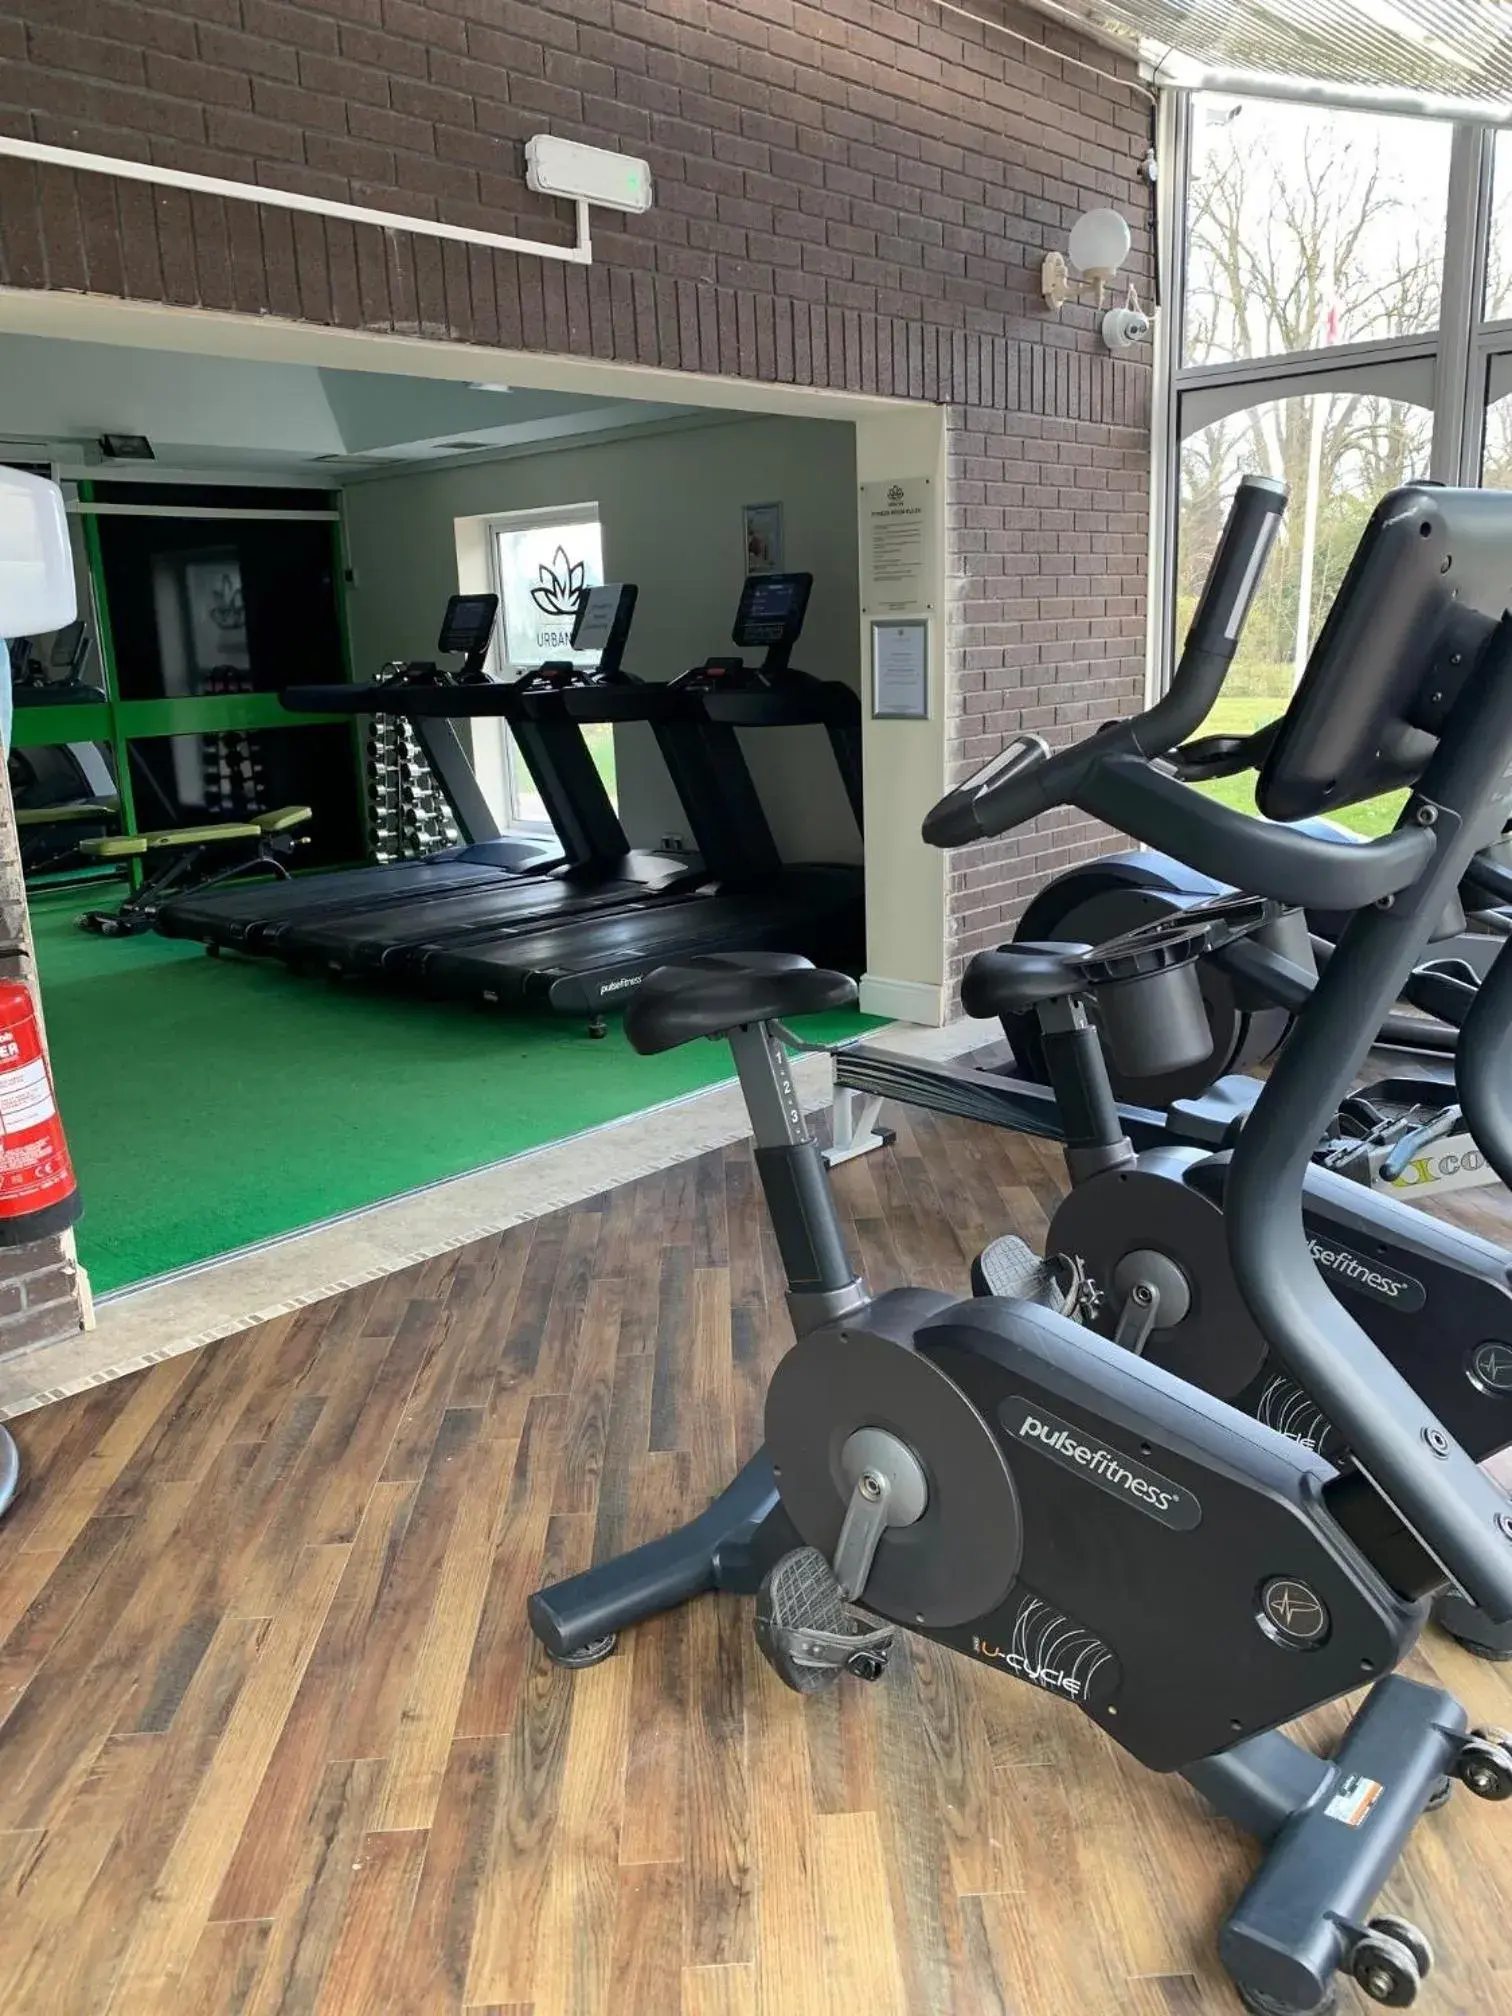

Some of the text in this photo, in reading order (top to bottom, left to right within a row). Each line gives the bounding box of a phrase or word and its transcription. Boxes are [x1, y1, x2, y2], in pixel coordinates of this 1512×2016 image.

[0, 1041, 19, 1058] ER
[775, 1052, 799, 1123] 1 2 3
[1306, 1239, 1401, 1296] lsefitness
[1019, 1416, 1174, 1510] pulsefitness
